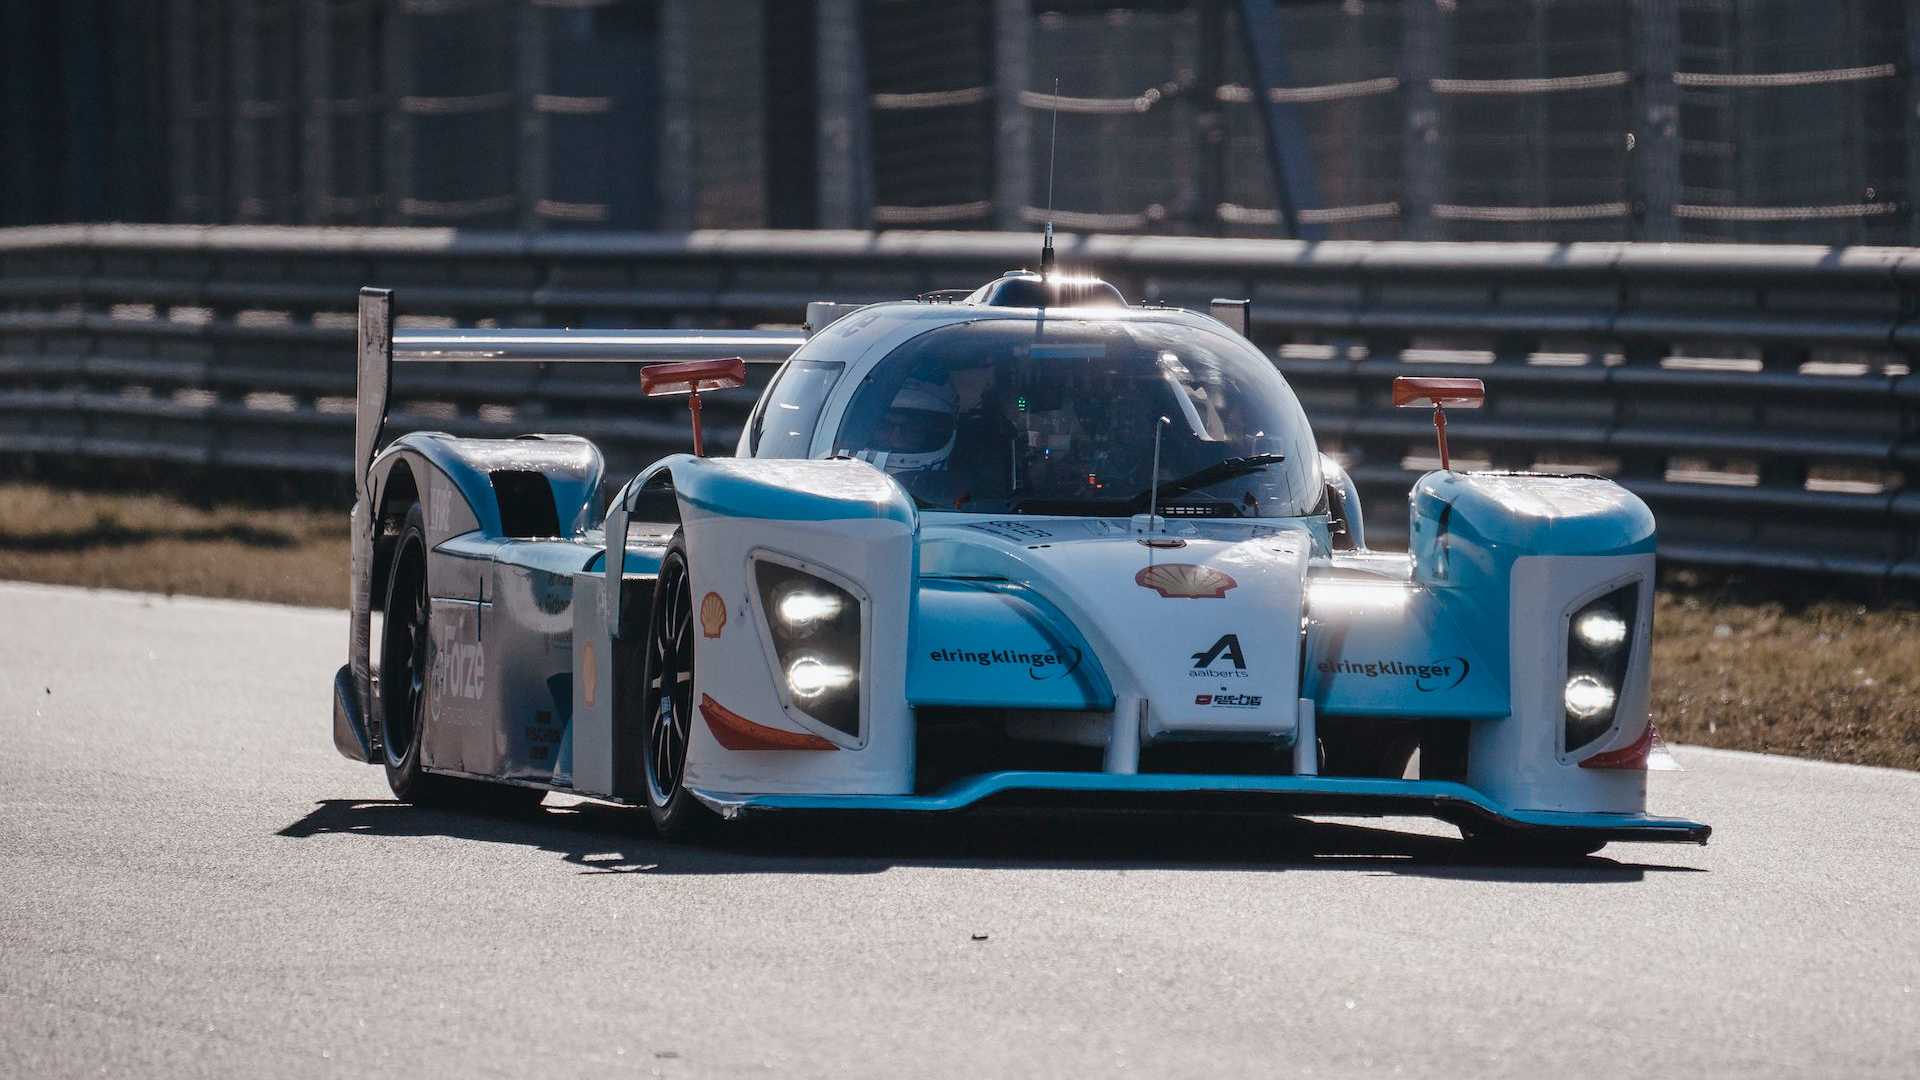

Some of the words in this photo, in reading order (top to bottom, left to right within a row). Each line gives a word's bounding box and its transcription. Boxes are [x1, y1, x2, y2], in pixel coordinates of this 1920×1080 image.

[443, 625, 485, 700] Forze
[930, 649, 1065, 667] elringklinger
[1188, 669, 1248, 678] aalberts
[1318, 660, 1452, 679] elringklinger
